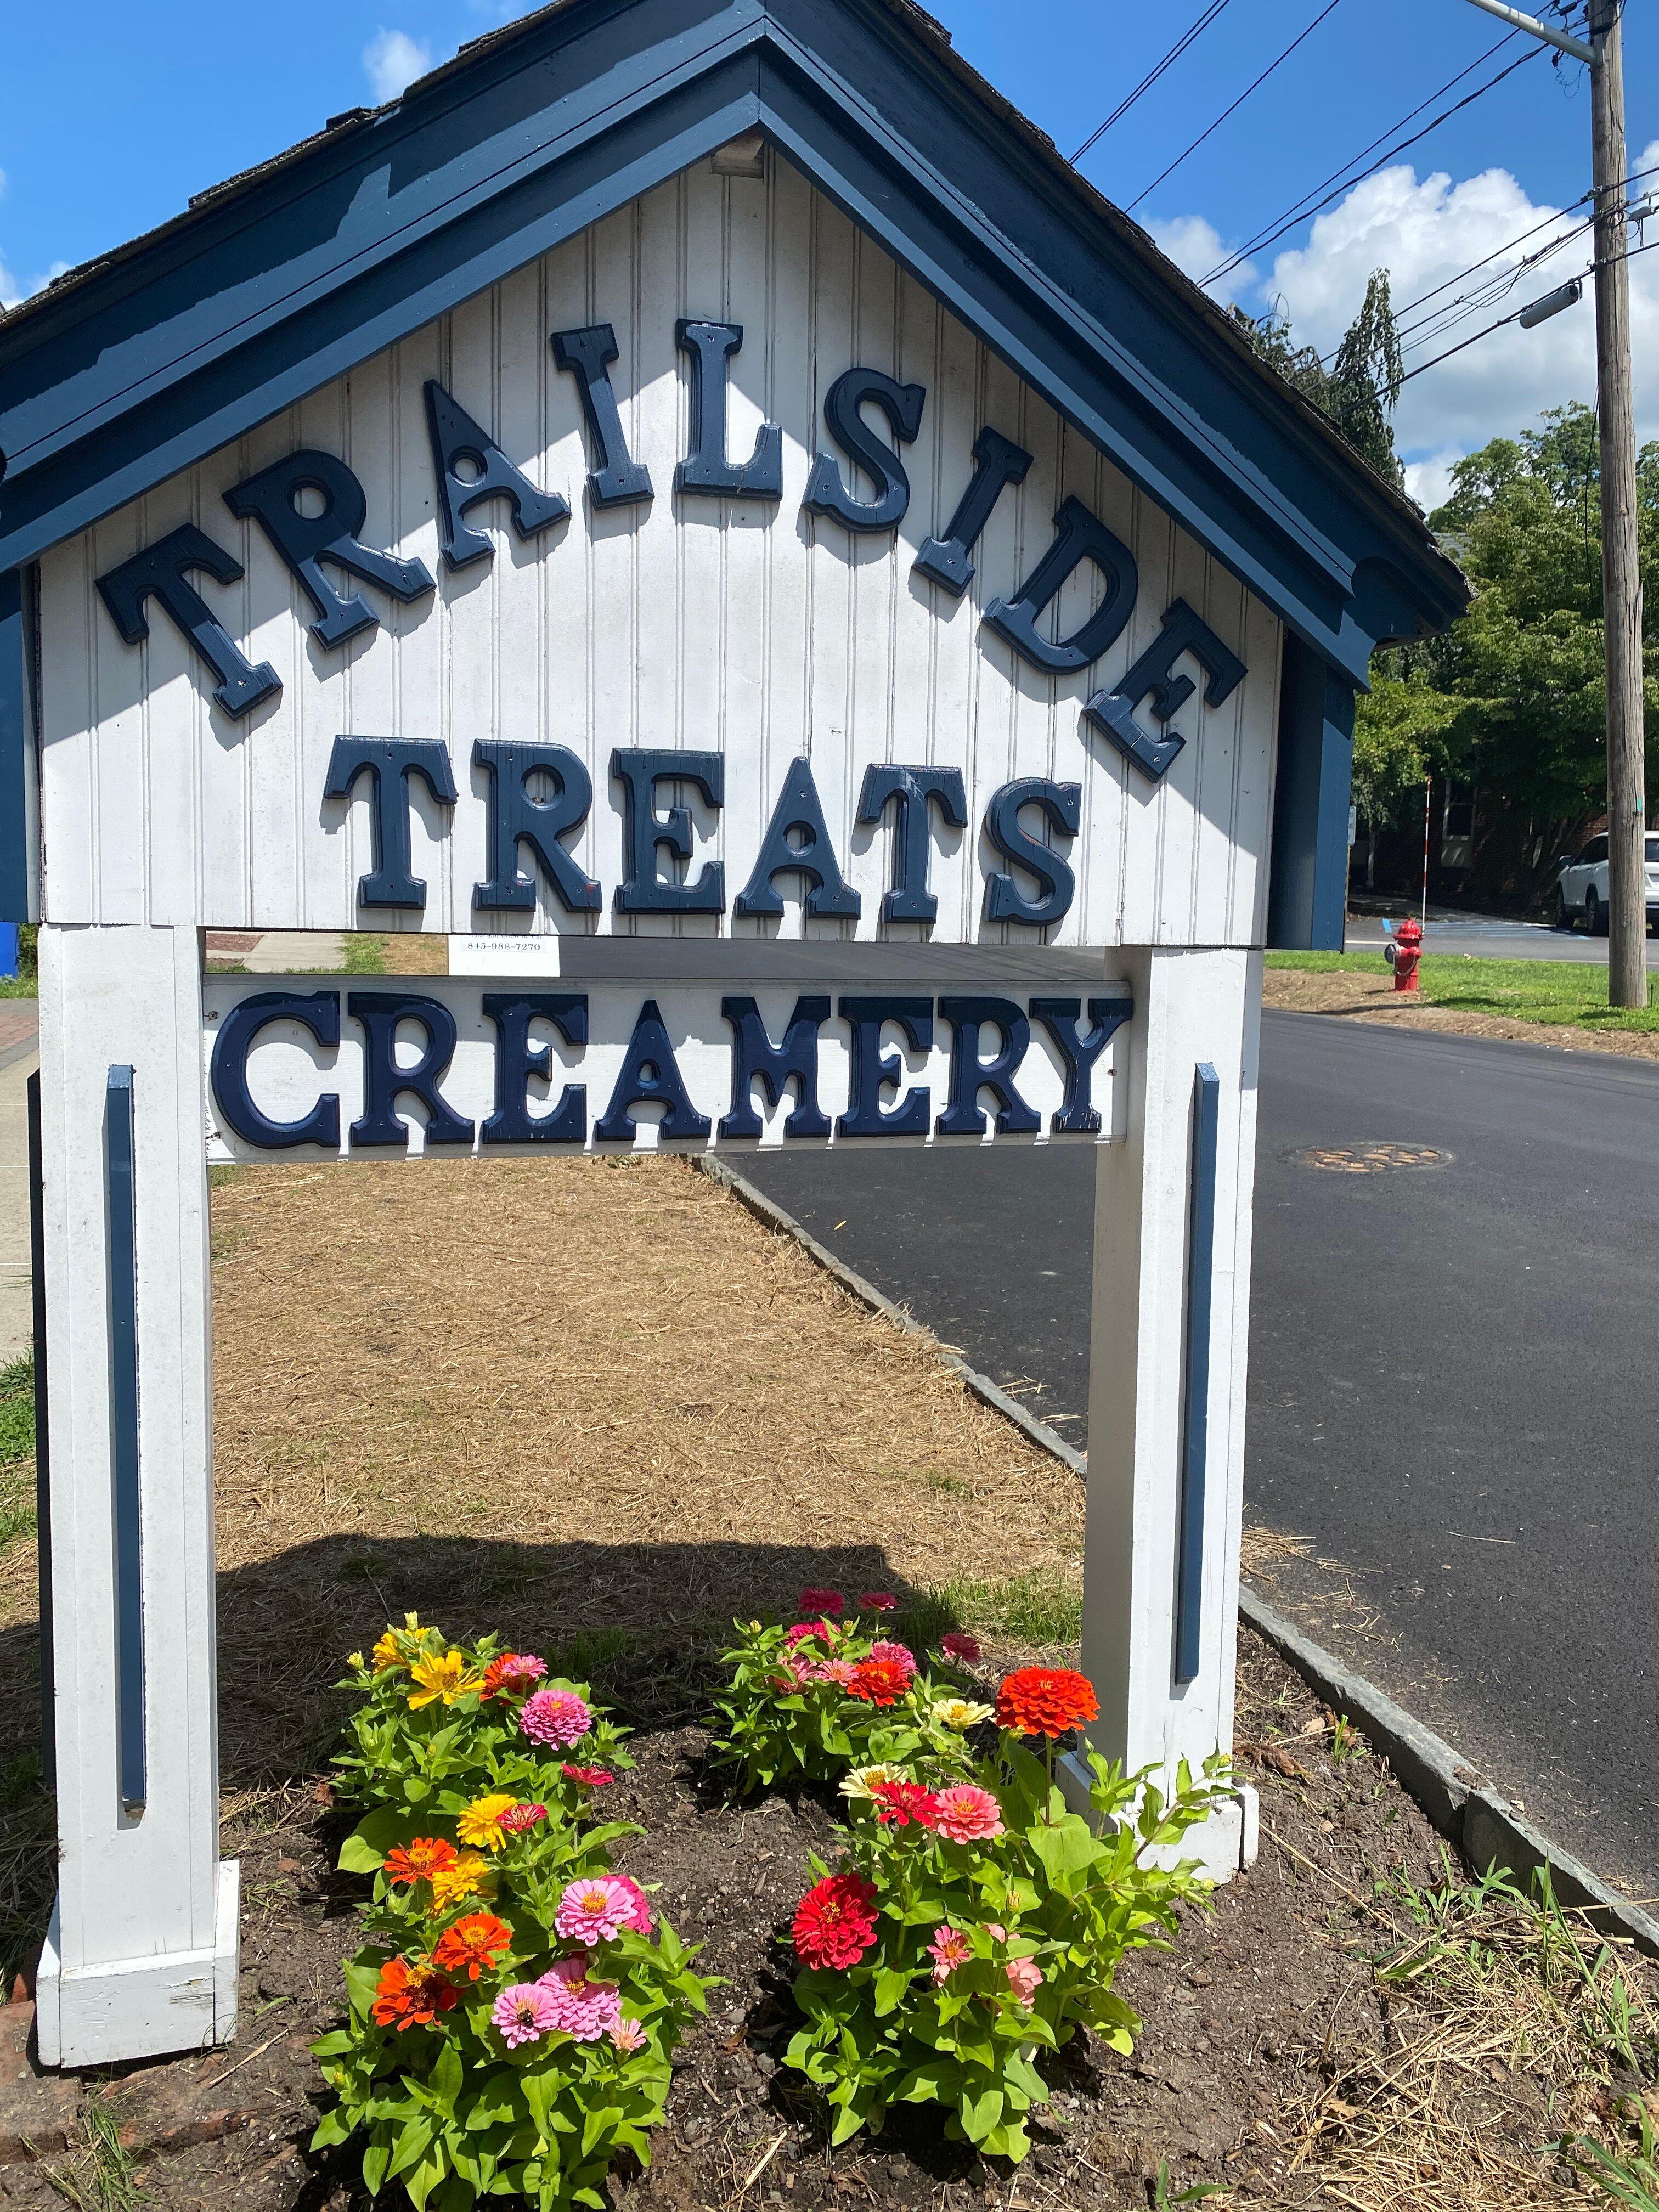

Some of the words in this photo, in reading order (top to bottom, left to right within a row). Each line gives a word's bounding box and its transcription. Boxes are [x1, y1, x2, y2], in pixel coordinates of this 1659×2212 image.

[95, 318, 1247, 782] TRAILSIDE
[325, 736, 1081, 926] TREATS
[467, 942, 540, 951] 845-988-7270
[211, 991, 1133, 1149] CREAMERY
